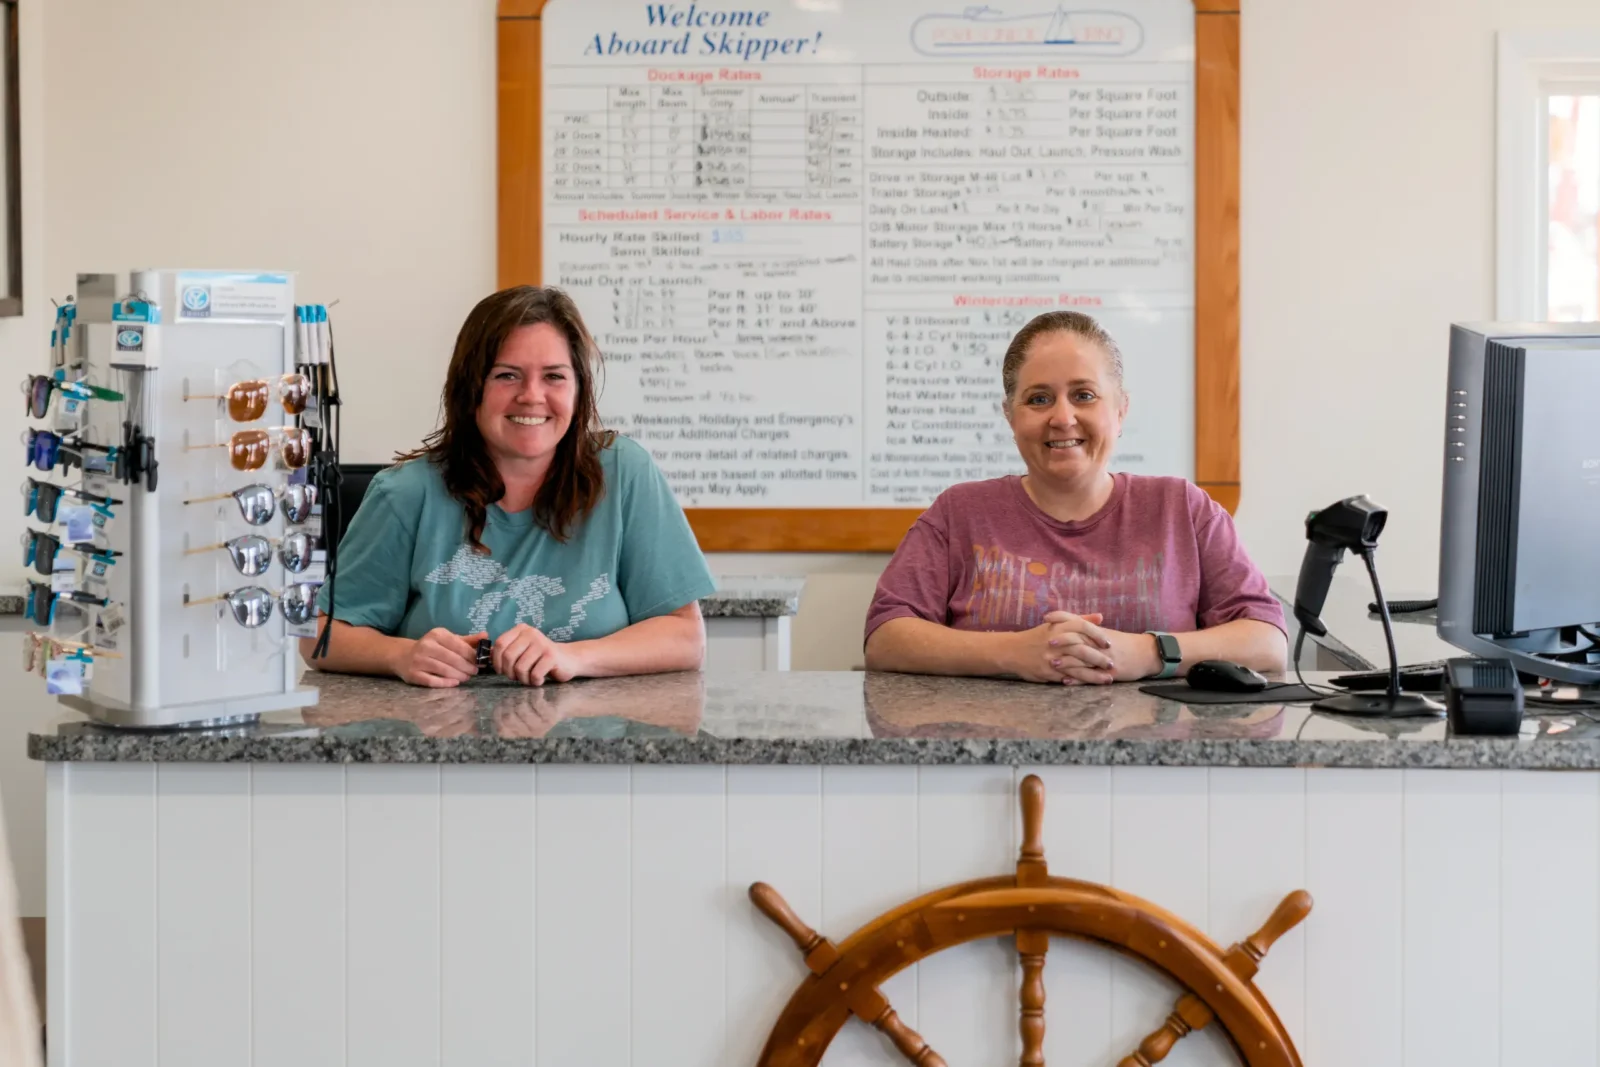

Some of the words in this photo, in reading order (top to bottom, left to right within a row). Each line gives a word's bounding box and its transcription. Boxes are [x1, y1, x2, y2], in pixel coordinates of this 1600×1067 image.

[645, 0, 770, 27] Welcome
[584, 31, 691, 56] Aboard
[698, 31, 823, 61] Skipper!
[647, 69, 713, 84] Dockage
[719, 68, 762, 81] Rates
[973, 66, 1031, 82] Storage
[1037, 66, 1080, 79] Rates
[619, 87, 640, 96] Max
[662, 87, 682, 96] Max
[700, 86, 744, 96] Summer
[1069, 88, 1091, 100] Per
[1095, 88, 1142, 103] Square
[1147, 88, 1177, 100] Foot
[658, 100, 688, 108] Beam
[709, 100, 734, 109] Only
[564, 115, 589, 124] PWC
[1069, 107, 1091, 119] Per
[1095, 107, 1142, 122] Square
[1147, 107, 1177, 119] Foot
[572, 131, 601, 140] Dock
[877, 127, 917, 138] Inside
[1069, 125, 1091, 137] Per
[1095, 125, 1142, 139] Square
[1147, 125, 1177, 137] Foot
[572, 146, 601, 155] Dock
[871, 146, 916, 160] Storage
[979, 146, 1006, 157] Haul
[1091, 145, 1144, 157] Pressure
[1148, 145, 1181, 157] Wash
[573, 163, 601, 172] Dock
[573, 178, 601, 187] Dock
[869, 172, 900, 183] Drive
[919, 172, 965, 184] Storage
[1001, 172, 1022, 182] Lot
[1094, 171, 1113, 182] Per
[713, 192, 740, 200] Winter
[870, 187, 908, 198] Trailer
[913, 187, 961, 199] Storage
[1045, 186, 1064, 196] Per
[578, 208, 658, 221] Scheduled
[664, 208, 719, 221] Service
[725, 208, 735, 220] &
[740, 208, 783, 220] Labor
[789, 208, 832, 220] Rates
[869, 205, 896, 216] Daily
[901, 204, 916, 214] On
[921, 204, 949, 214] Land
[1025, 204, 1040, 213] Per
[1043, 204, 1060, 214] Day
[1144, 203, 1161, 212] Per
[1164, 203, 1184, 214] Day
[896, 222, 928, 232] Motor
[933, 222, 978, 234] Storage
[983, 222, 1006, 232] Max
[1028, 222, 1062, 232] Horse
[559, 232, 607, 244] Hourly
[613, 232, 646, 242] Rate
[870, 238, 908, 249] Battery
[912, 238, 953, 250] Storage
[1014, 238, 1053, 250] Battery
[1057, 237, 1105, 248] Removal
[610, 246, 646, 257] Semi
[871, 257, 883, 267] All
[887, 257, 911, 267] Haul
[942, 257, 963, 267] after
[1010, 257, 1027, 267] will
[1031, 257, 1043, 266] be
[1093, 258, 1104, 266] an
[1108, 256, 1160, 266] additional
[560, 275, 592, 286] Haul
[598, 275, 624, 286] Out
[629, 277, 642, 286] or
[892, 274, 902, 283] to
[906, 274, 956, 283] inclement
[961, 274, 1001, 286] working
[708, 289, 731, 299] Per
[754, 291, 772, 301] up
[777, 289, 791, 299] to
[953, 295, 1053, 307] Winterization
[1058, 295, 1102, 307] Rates
[708, 304, 731, 314] Per
[779, 304, 793, 314] to
[708, 318, 731, 328] Per
[780, 318, 806, 328] and
[811, 318, 856, 328] Above
[915, 316, 970, 325] Inboard
[605, 334, 638, 344] Time
[643, 334, 666, 344] Per
[673, 334, 708, 344] Hour
[956, 330, 1010, 340] Inboard
[886, 375, 950, 385] Pressure
[954, 375, 995, 385] Water
[886, 391, 911, 400] Hot
[916, 391, 956, 400] Water
[886, 405, 934, 415] Marine
[939, 405, 976, 415] Head
[698, 413, 749, 427] Holidays
[754, 414, 774, 424] and
[778, 413, 853, 427] Emergency's
[886, 420, 906, 430] Air
[912, 420, 995, 430] Conditioner
[646, 429, 675, 439] incur
[679, 428, 737, 439] Additional
[741, 429, 790, 441] Charges
[886, 435, 906, 445] Ice
[912, 435, 954, 445] Maker
[652, 449, 668, 459] for
[672, 451, 701, 459] more
[708, 449, 738, 459] detail
[741, 449, 753, 459] of
[757, 449, 797, 459] related
[701, 471, 717, 479] are
[721, 469, 756, 479] based
[762, 471, 775, 479] on
[779, 469, 822, 479] allotted
[826, 469, 857, 479] times
[708, 483, 731, 495] May
